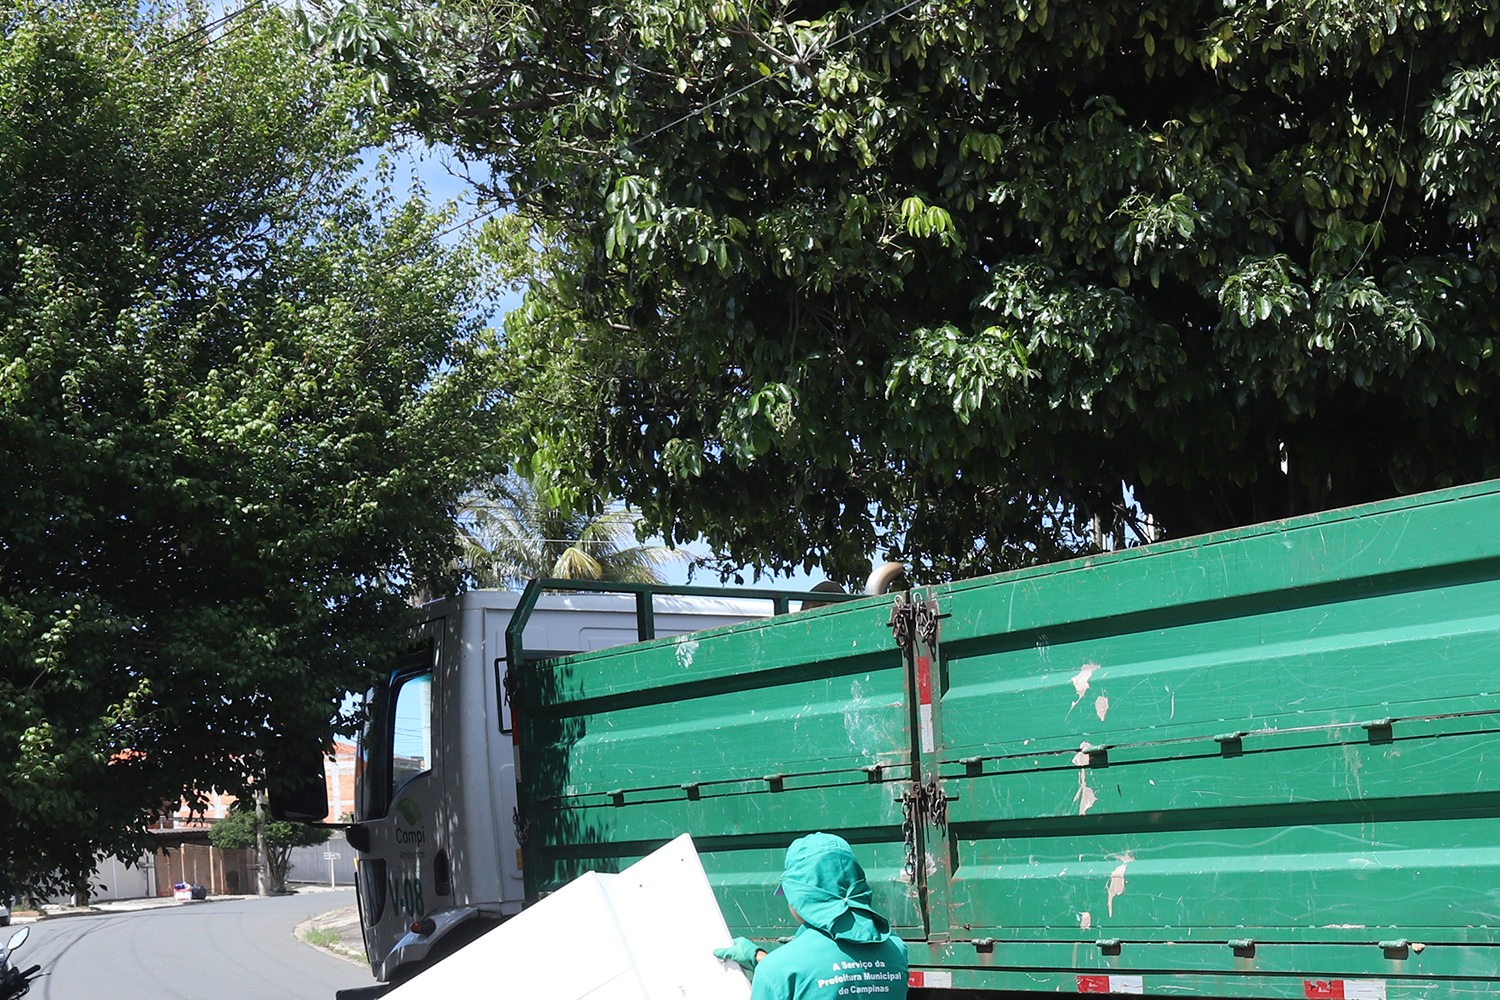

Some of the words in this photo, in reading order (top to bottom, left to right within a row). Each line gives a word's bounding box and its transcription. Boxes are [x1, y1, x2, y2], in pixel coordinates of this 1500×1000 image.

[396, 826, 425, 847] Campi
[388, 878, 425, 917] V-08
[832, 962, 841, 972] A
[841, 960, 873, 969] Serviço
[874, 960, 886, 968] da
[817, 973, 862, 988] Prefeitura
[863, 972, 902, 981] Municipal
[838, 987, 849, 995] de
[850, 984, 890, 994] Campinas
